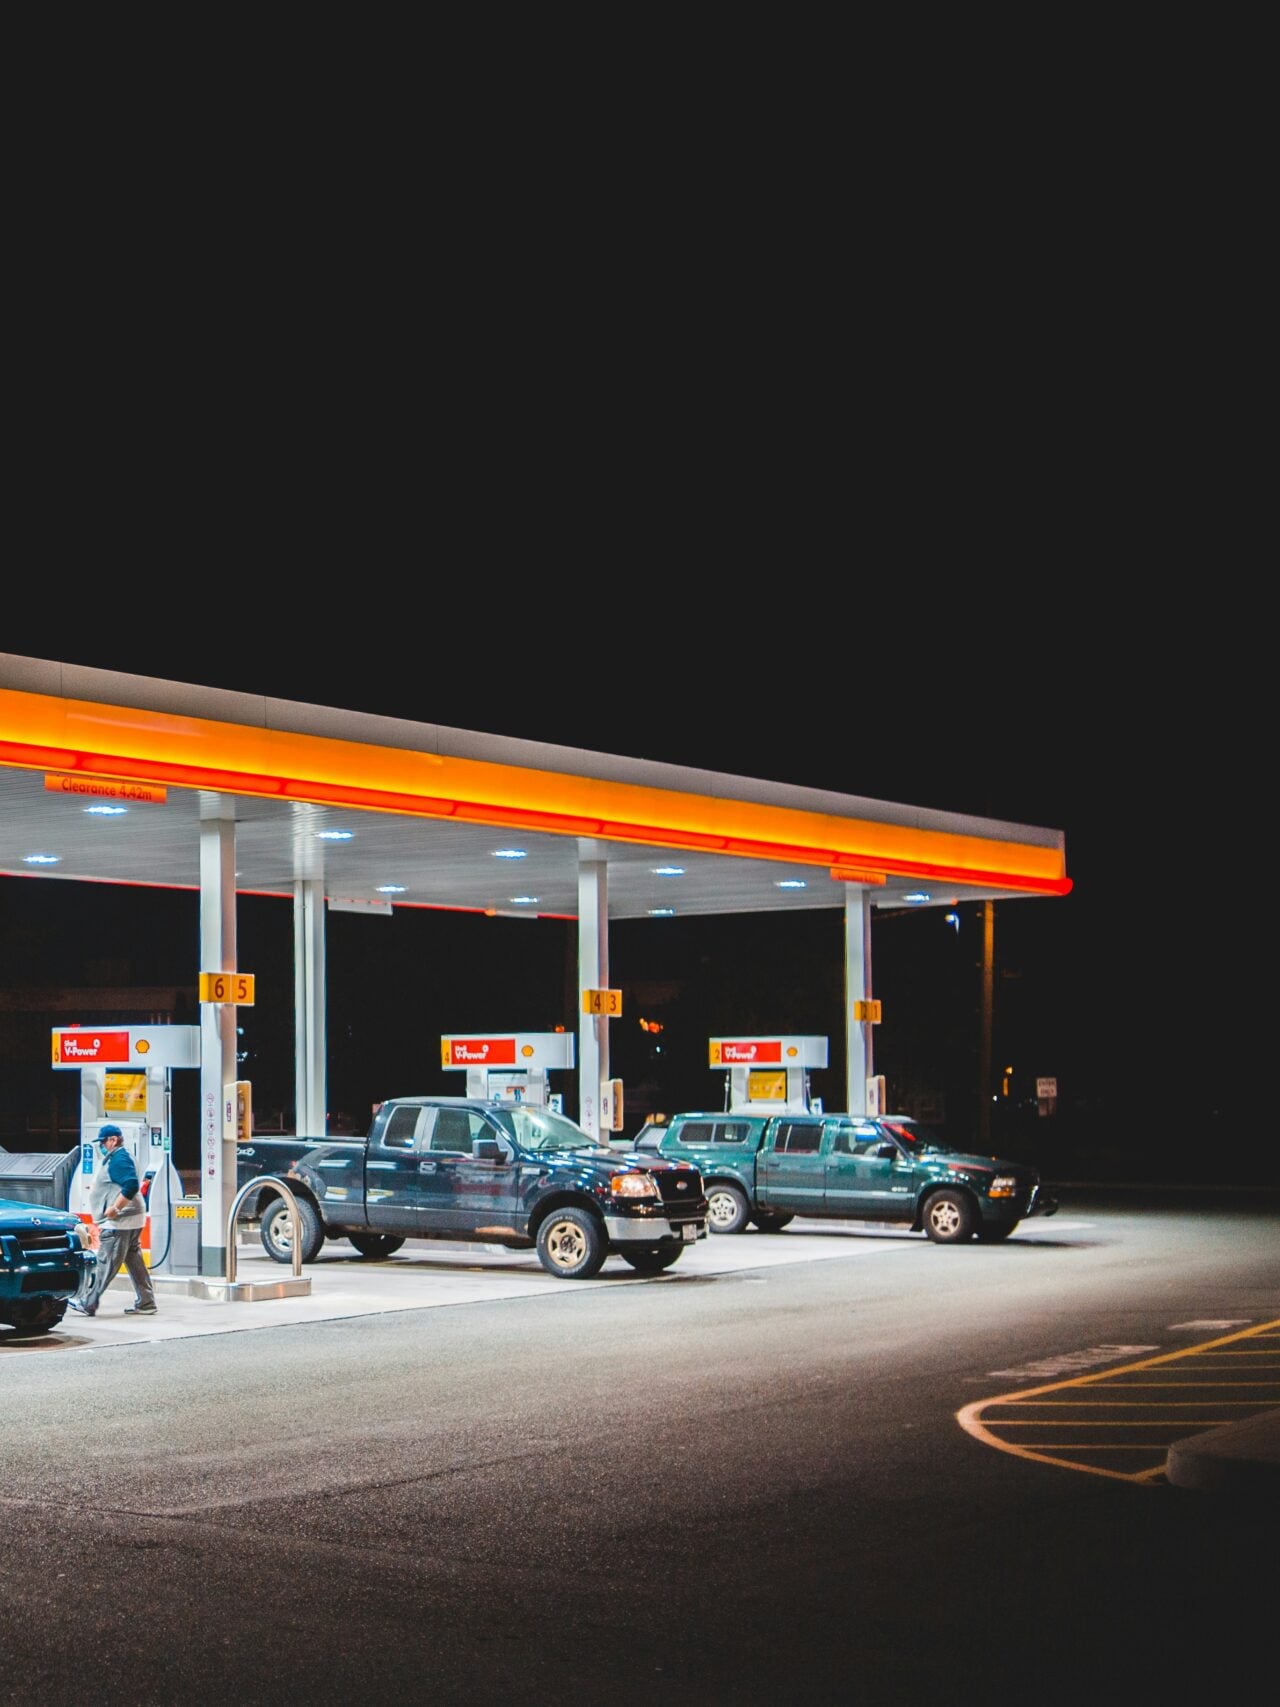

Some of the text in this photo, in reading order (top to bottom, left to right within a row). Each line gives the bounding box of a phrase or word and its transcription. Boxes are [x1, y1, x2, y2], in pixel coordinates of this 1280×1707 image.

[61, 778, 152, 801] Clearance 4.42m
[214, 977, 225, 999] 6
[237, 979, 247, 1000] 5
[594, 993, 601, 1011] 4
[609, 994, 617, 1012] 3
[64, 1039, 77, 1047] Shell
[64, 1046, 97, 1057] V-Power
[455, 1050, 487, 1060] V-Power
